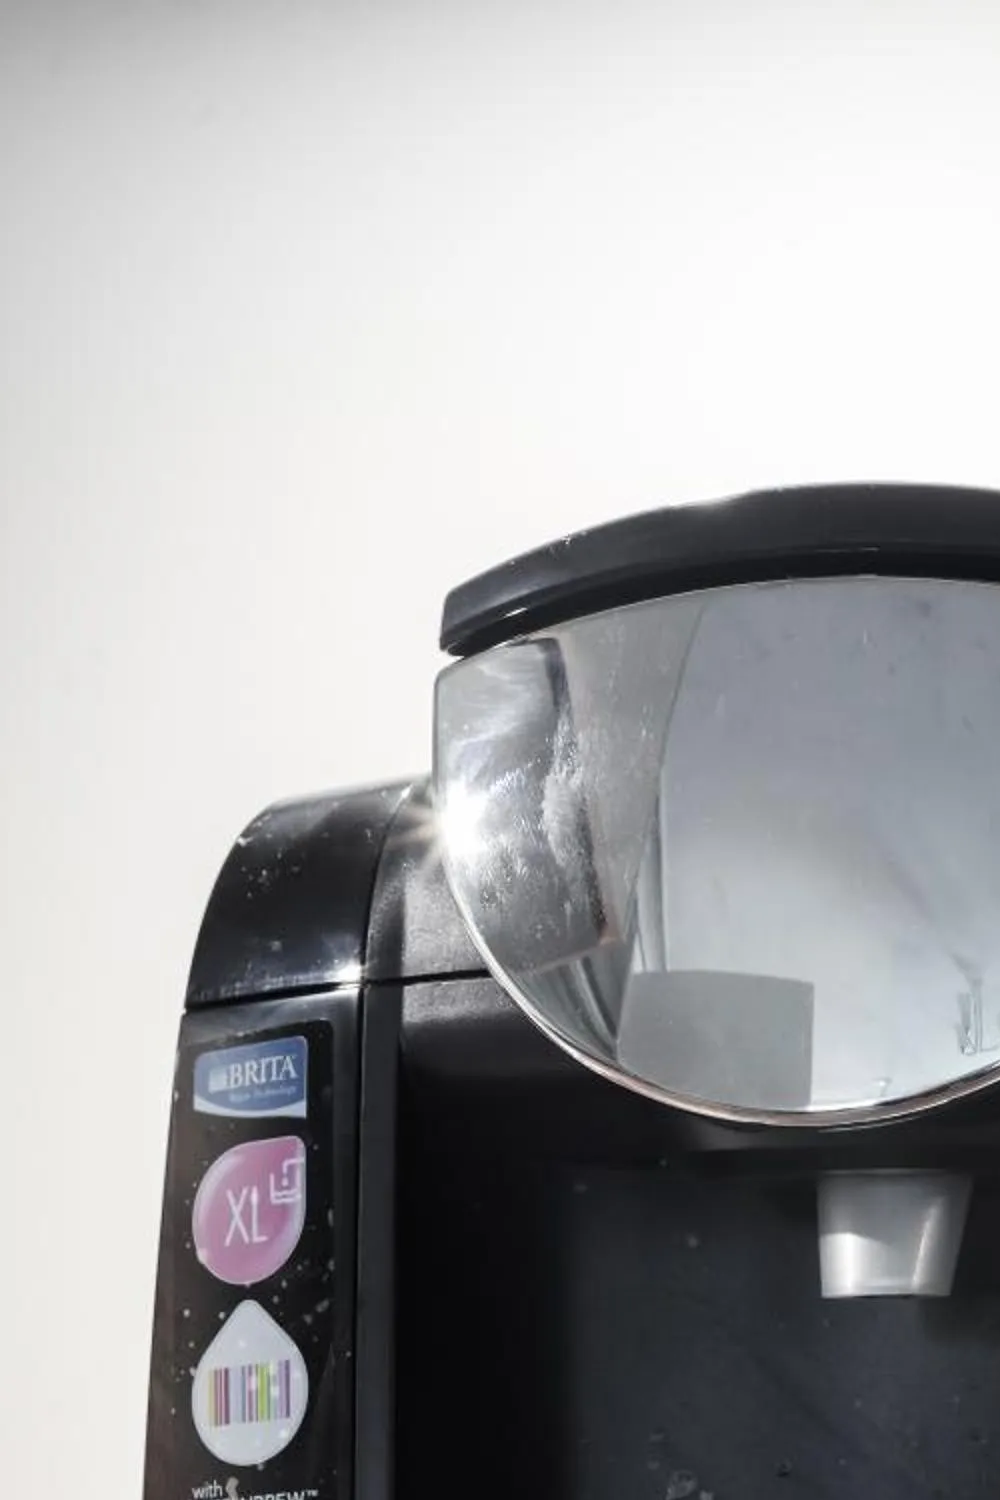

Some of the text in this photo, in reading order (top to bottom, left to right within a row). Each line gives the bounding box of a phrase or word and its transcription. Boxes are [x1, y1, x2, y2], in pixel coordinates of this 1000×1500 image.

[229, 1055, 298, 1088] BRITA
[224, 1186, 268, 1246] XL
[191, 1480, 223, 1499] with
